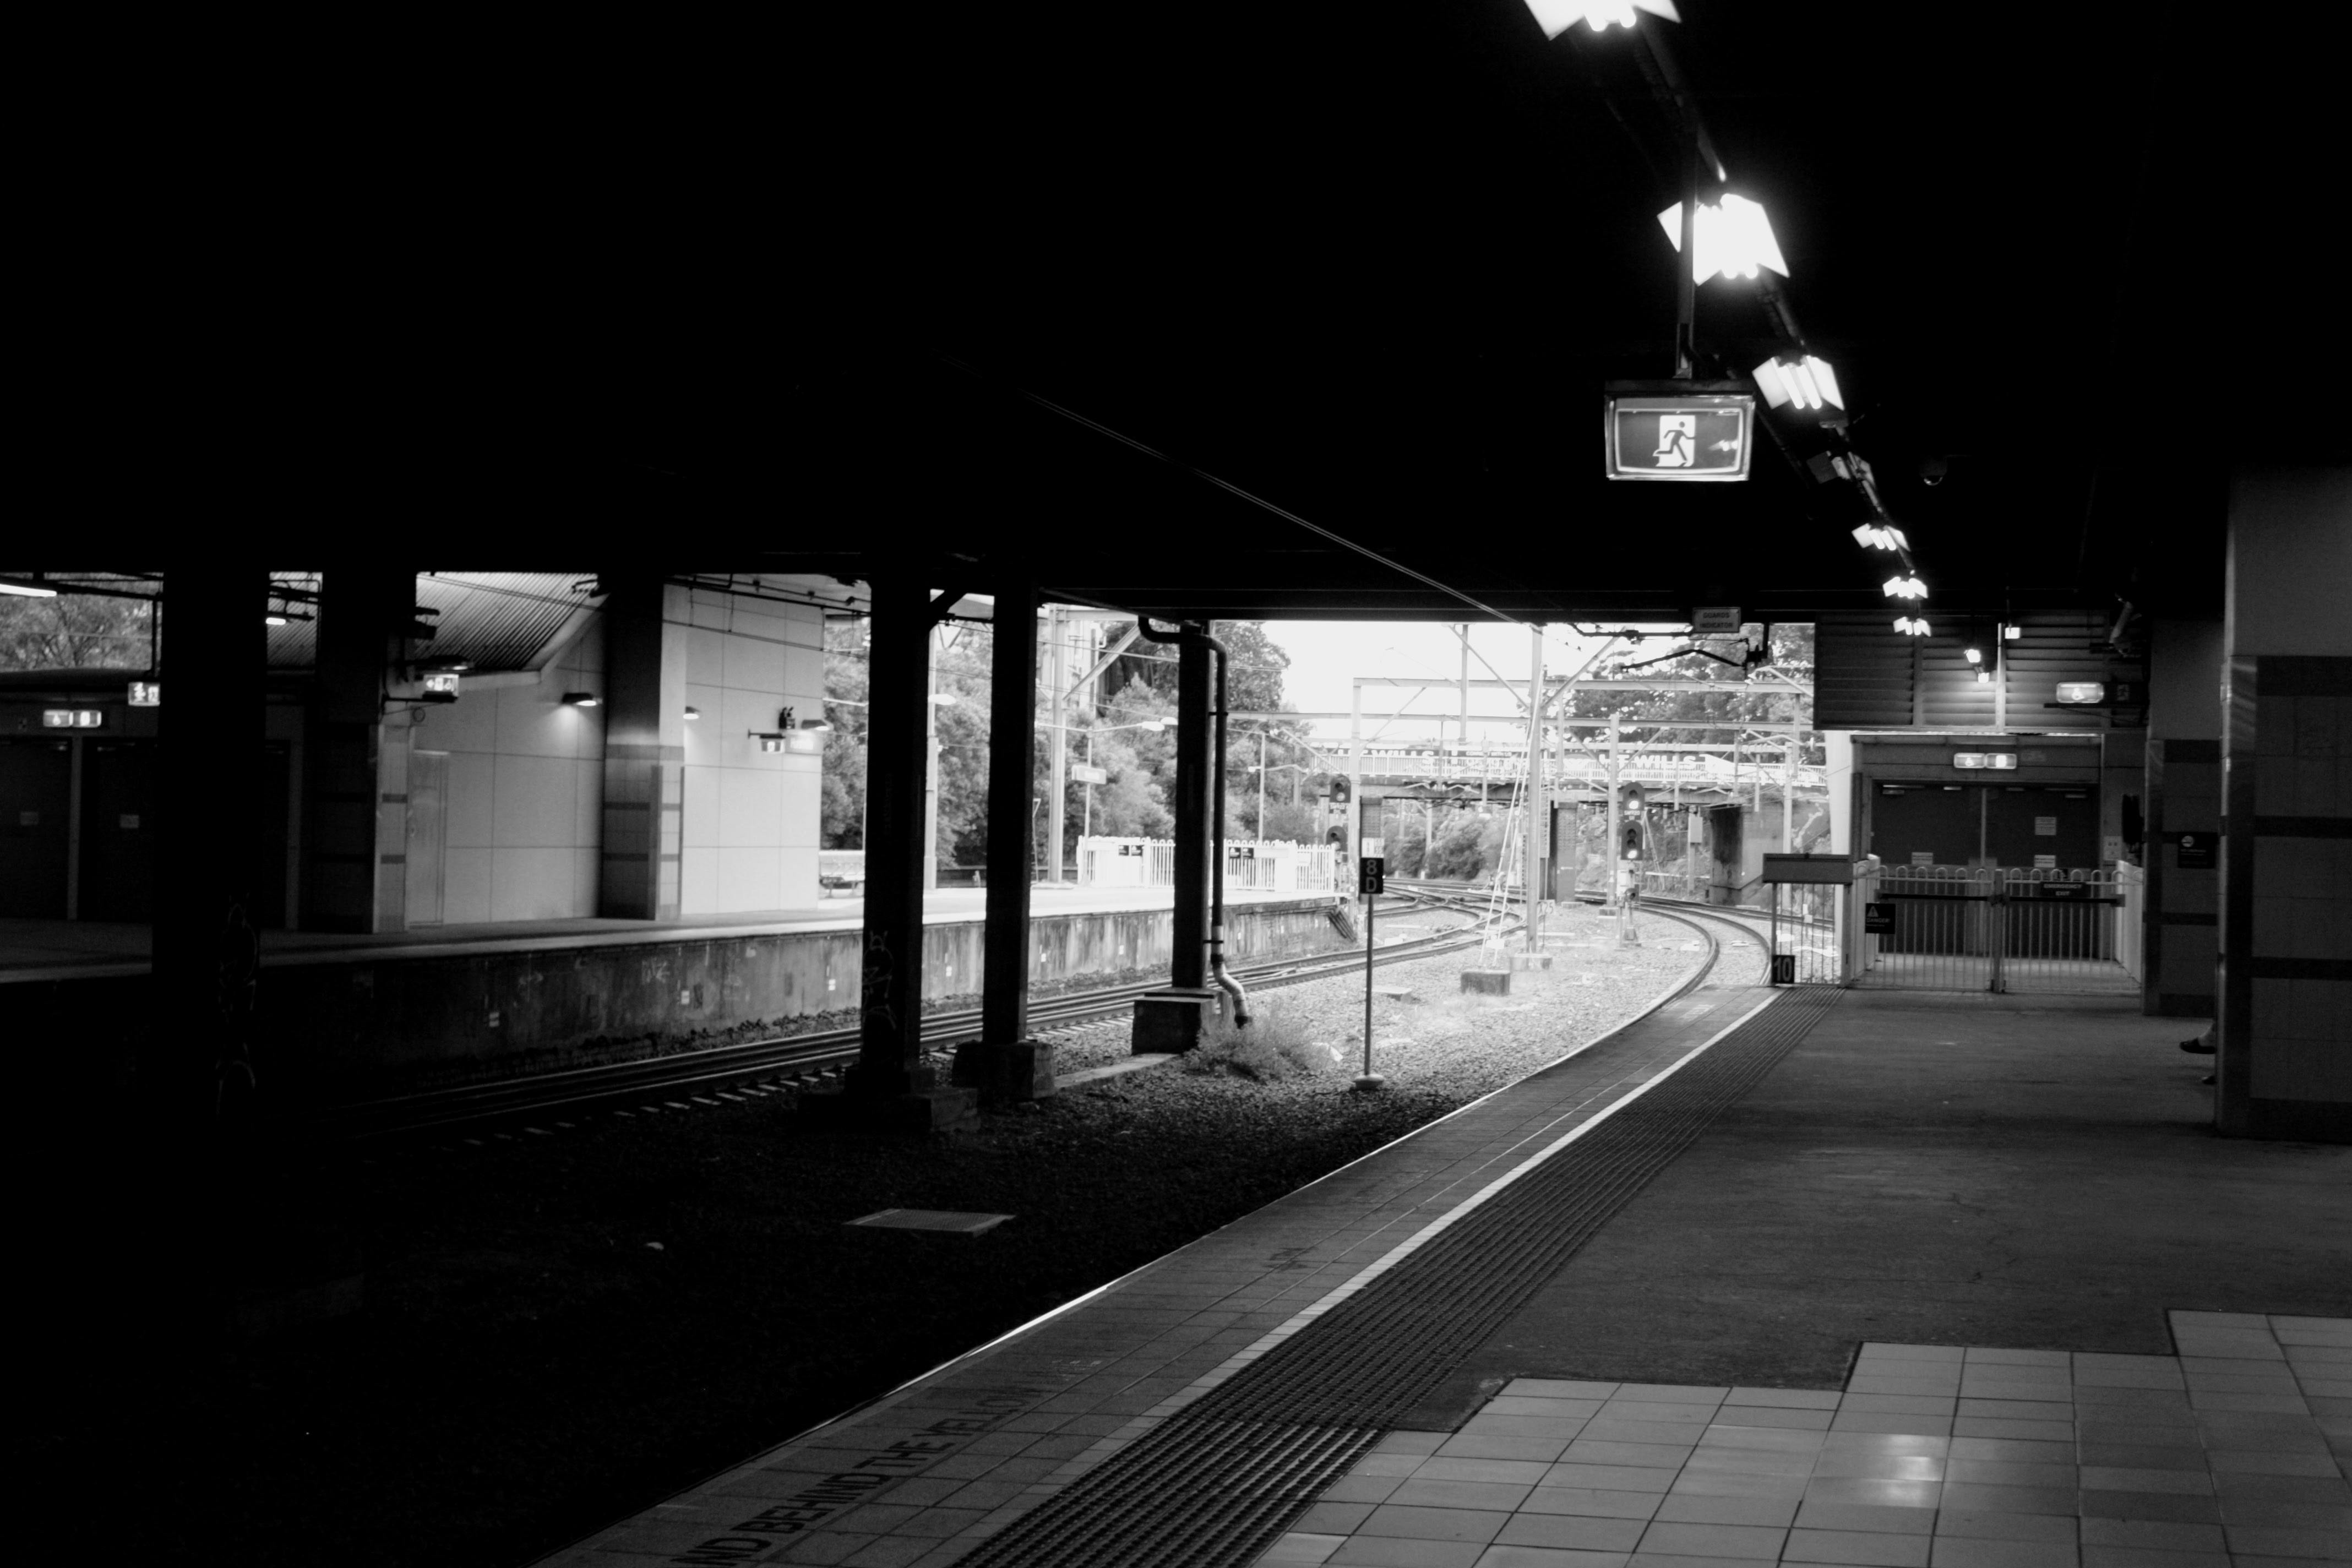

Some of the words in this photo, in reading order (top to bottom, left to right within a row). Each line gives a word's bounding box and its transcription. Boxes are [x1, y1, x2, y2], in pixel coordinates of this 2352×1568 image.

[1366, 859, 1377, 875] 8
[1365, 876, 1377, 892] D
[1773, 956, 1793, 982] 10
[730, 1473, 891, 1534] BEHIND
[852, 1441, 956, 1468] THE
